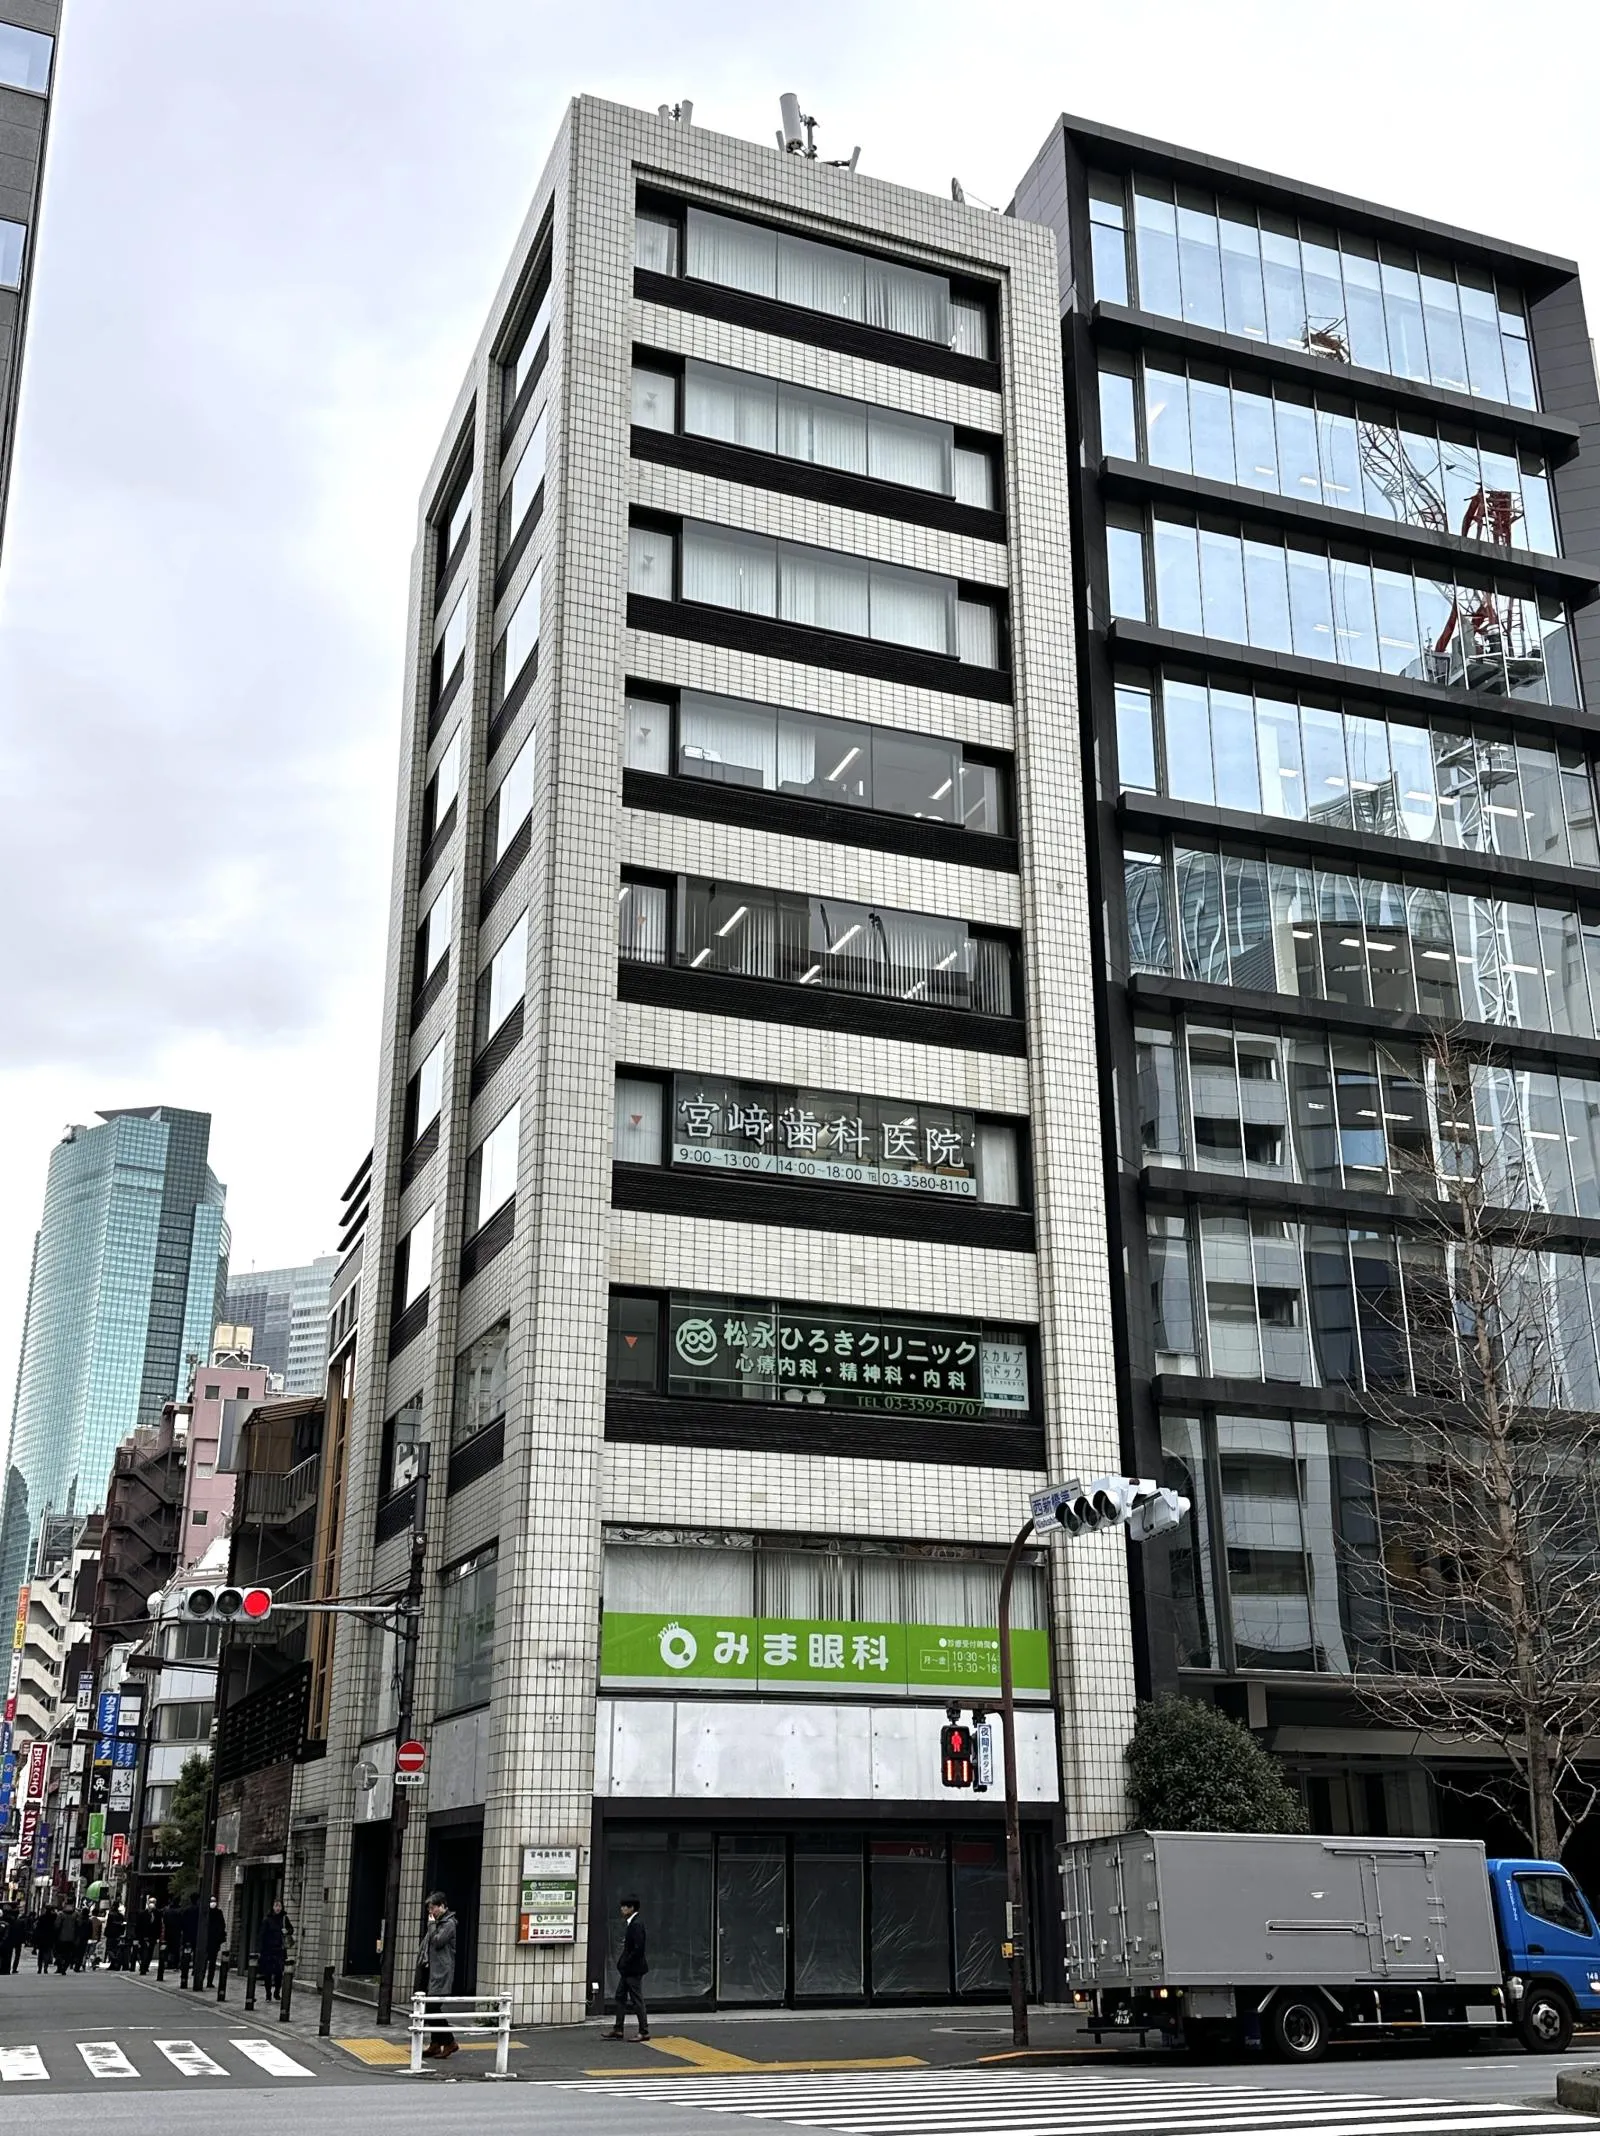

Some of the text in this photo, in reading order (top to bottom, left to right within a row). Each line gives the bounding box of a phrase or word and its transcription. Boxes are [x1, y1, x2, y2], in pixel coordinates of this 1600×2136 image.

[881, 1172, 971, 1194] 03-3580-8110
[723, 1318, 976, 1365] 松永ひろきクリニック
[735, 1353, 967, 1391] 心療内科・精神科・内科
[885, 1396, 984, 1417] 03-3595-0707
[713, 1631, 889, 1672] みま眼科
[29, 1747, 43, 1795] BIG ECHO
